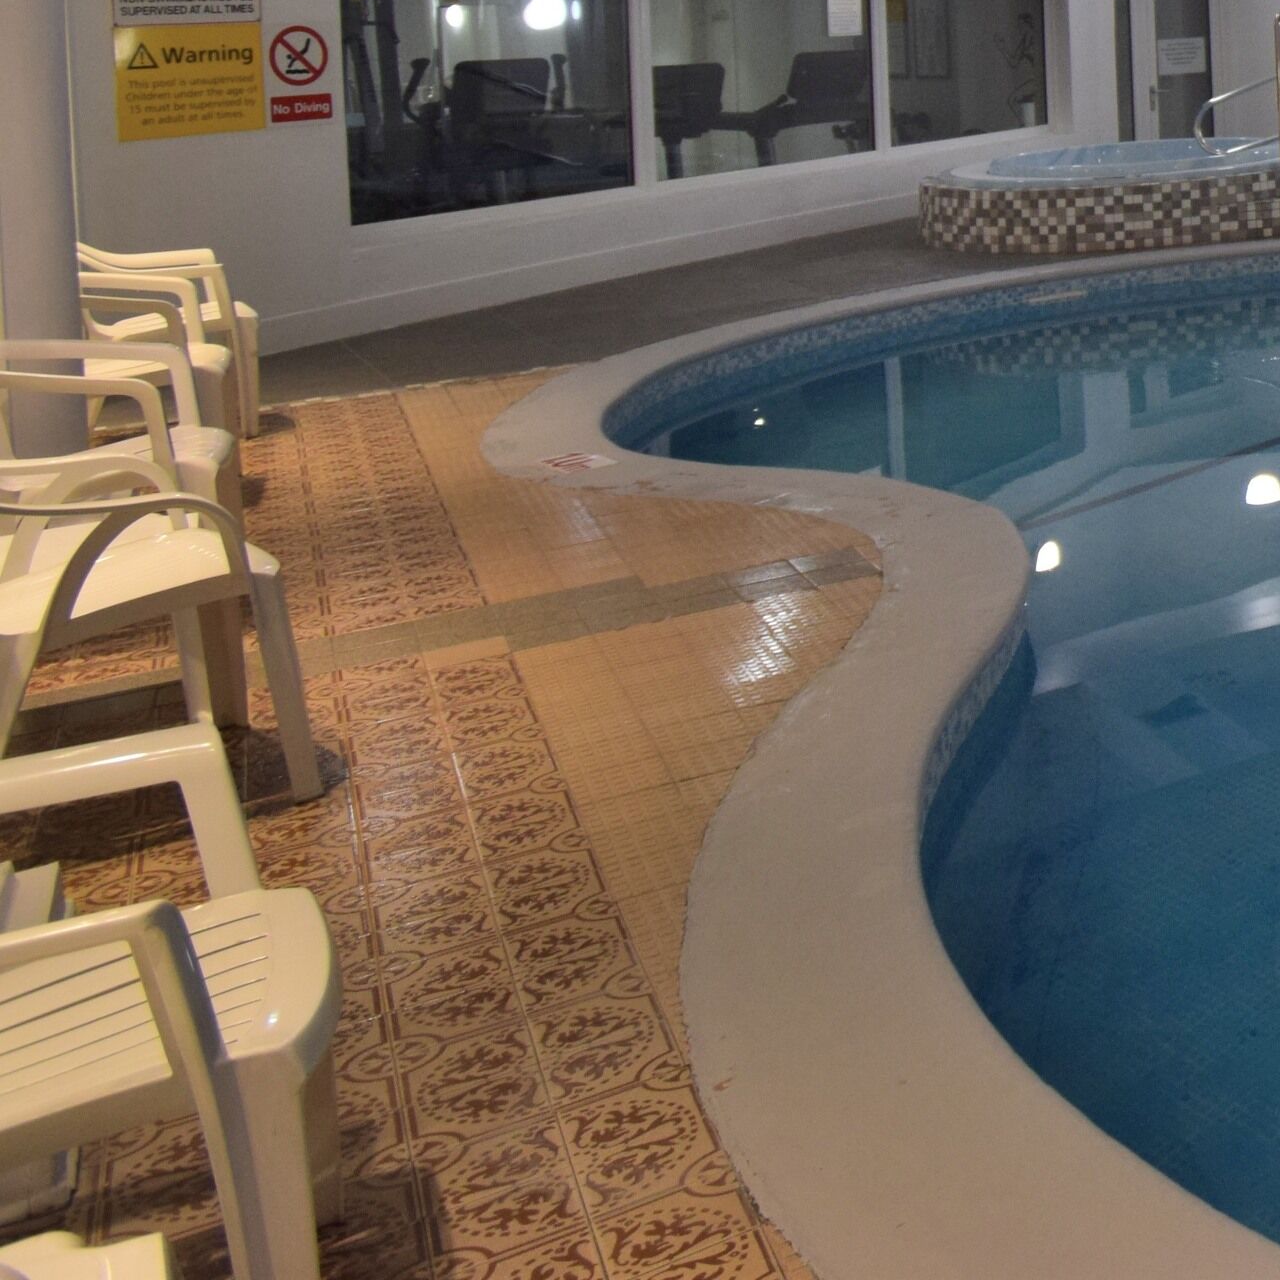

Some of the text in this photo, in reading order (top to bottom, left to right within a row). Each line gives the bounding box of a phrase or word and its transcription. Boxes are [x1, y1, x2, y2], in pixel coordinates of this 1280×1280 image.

[120, 4, 254, 16] SUPERVISED AT ALL TIMES
[161, 44, 254, 64] Warning
[125, 91, 170, 102] Children
[174, 89, 204, 99] under
[207, 88, 224, 96] the
[226, 88, 244, 98] age
[144, 103, 170, 113] must
[173, 102, 186, 111] be
[188, 98, 242, 110] supervised
[244, 97, 256, 107] by
[273, 100, 330, 115] No Diving
[142, 117, 155, 125] an
[158, 114, 186, 124] adult
[188, 113, 198, 122] at
[201, 112, 214, 120] all
